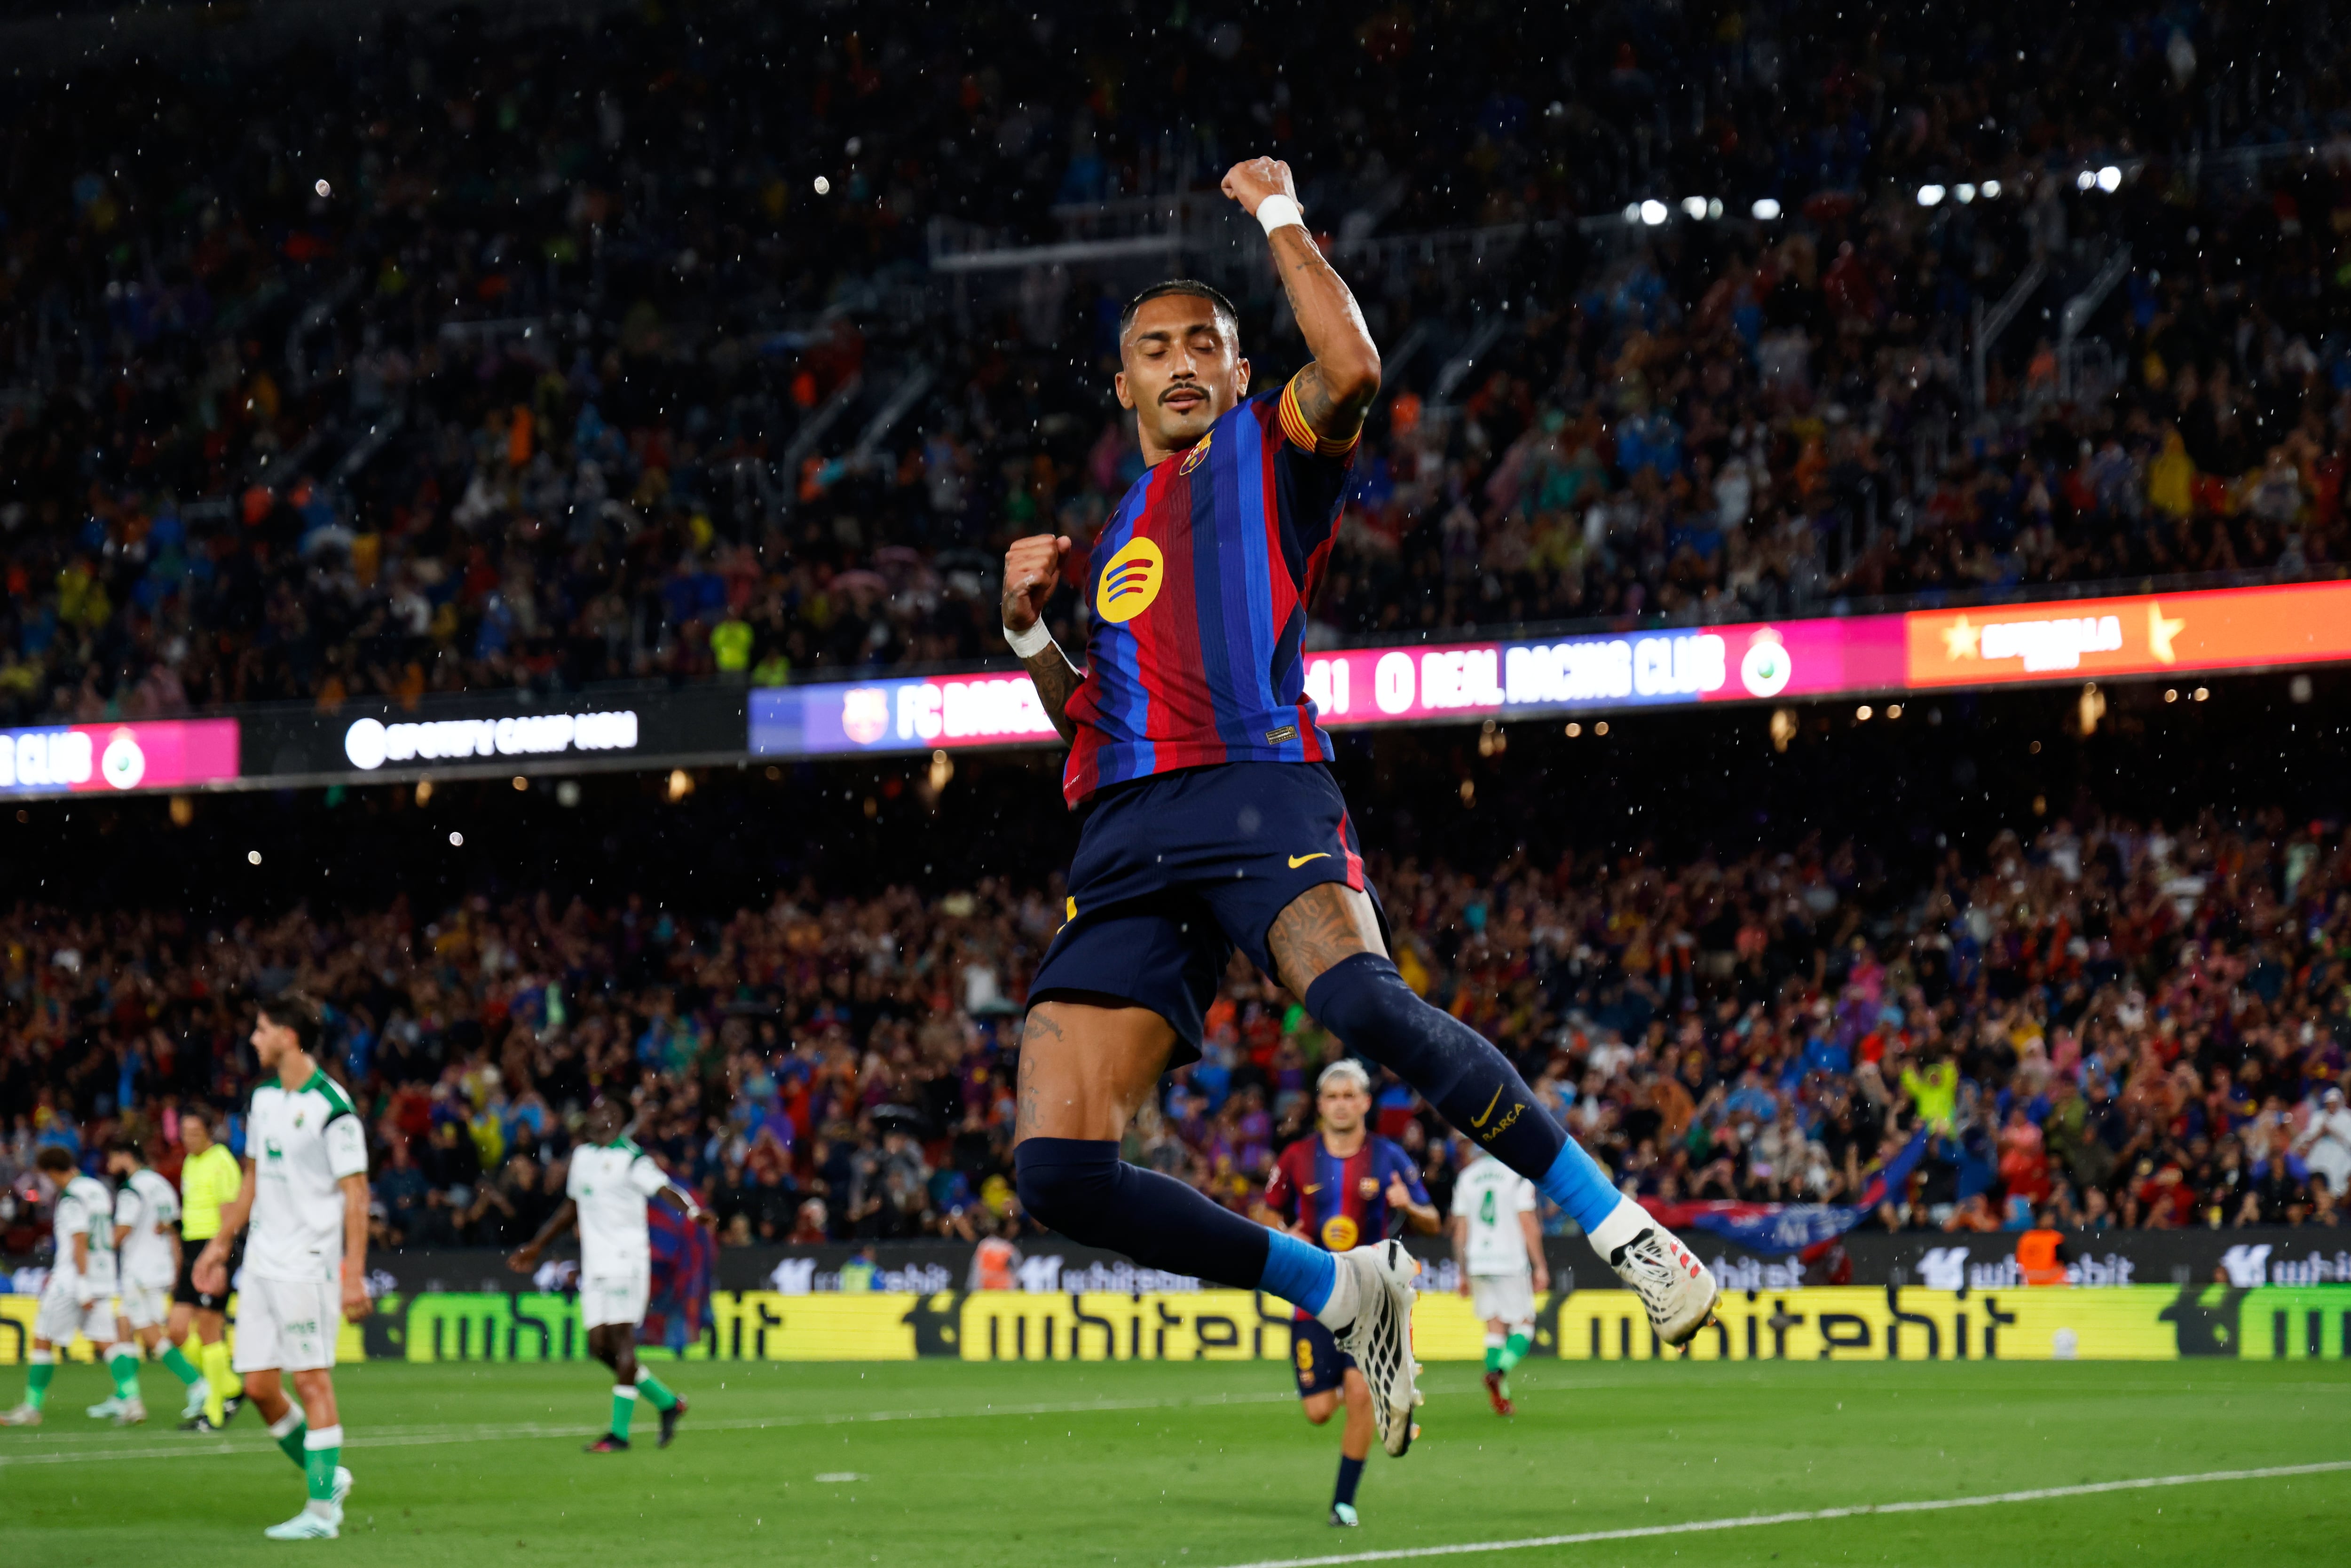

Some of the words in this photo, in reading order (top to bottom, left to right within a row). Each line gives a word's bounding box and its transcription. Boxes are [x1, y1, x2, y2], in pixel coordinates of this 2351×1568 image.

[1482, 1103, 1525, 1142] BARÇA
[1480, 1190, 1495, 1229] 4
[1296, 1338, 1314, 1370] 8
